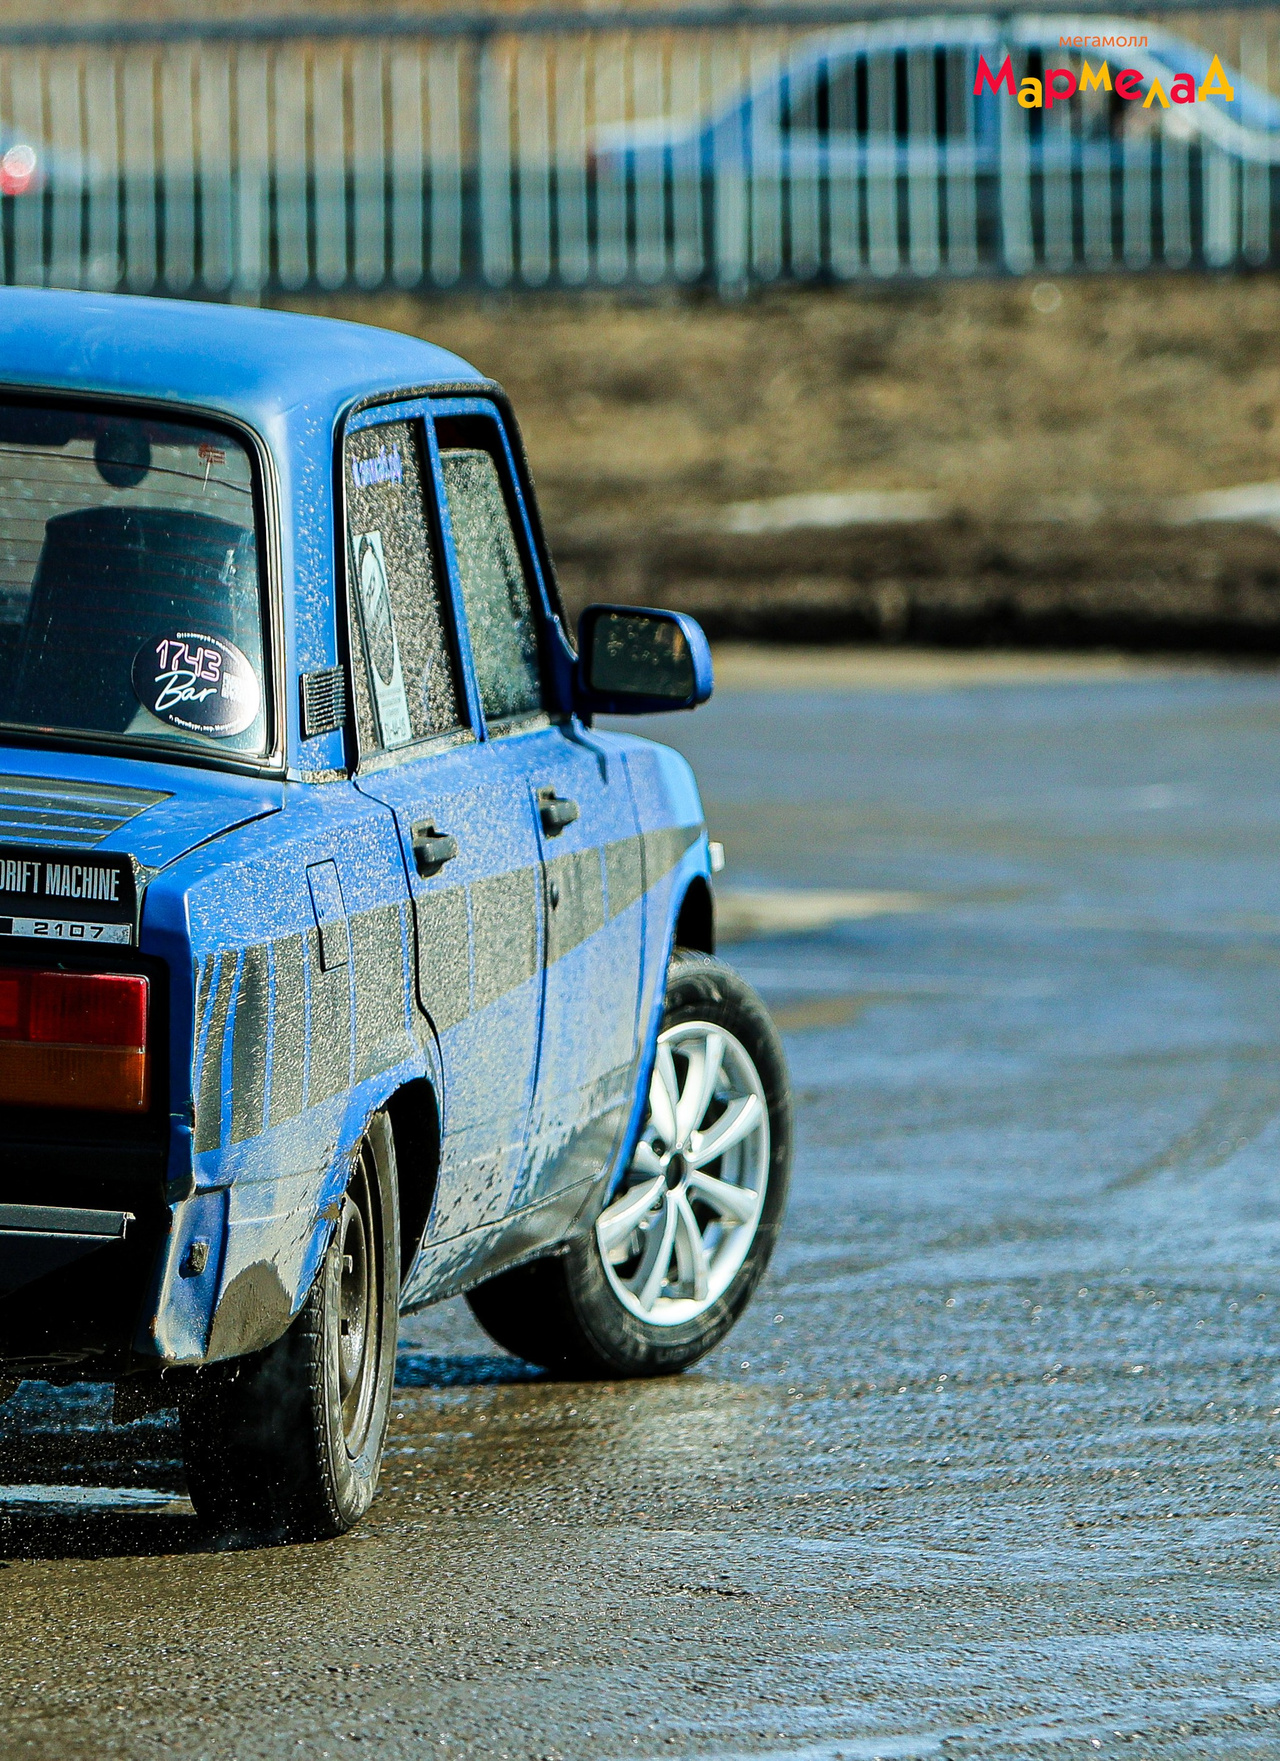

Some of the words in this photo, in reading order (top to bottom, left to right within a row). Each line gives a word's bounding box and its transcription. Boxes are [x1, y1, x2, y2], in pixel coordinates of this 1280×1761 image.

[155, 639, 223, 683] 1743
[154, 670, 218, 712] Bar
[45, 863, 120, 901] MACHINE
[33, 922, 104, 940] 2107
